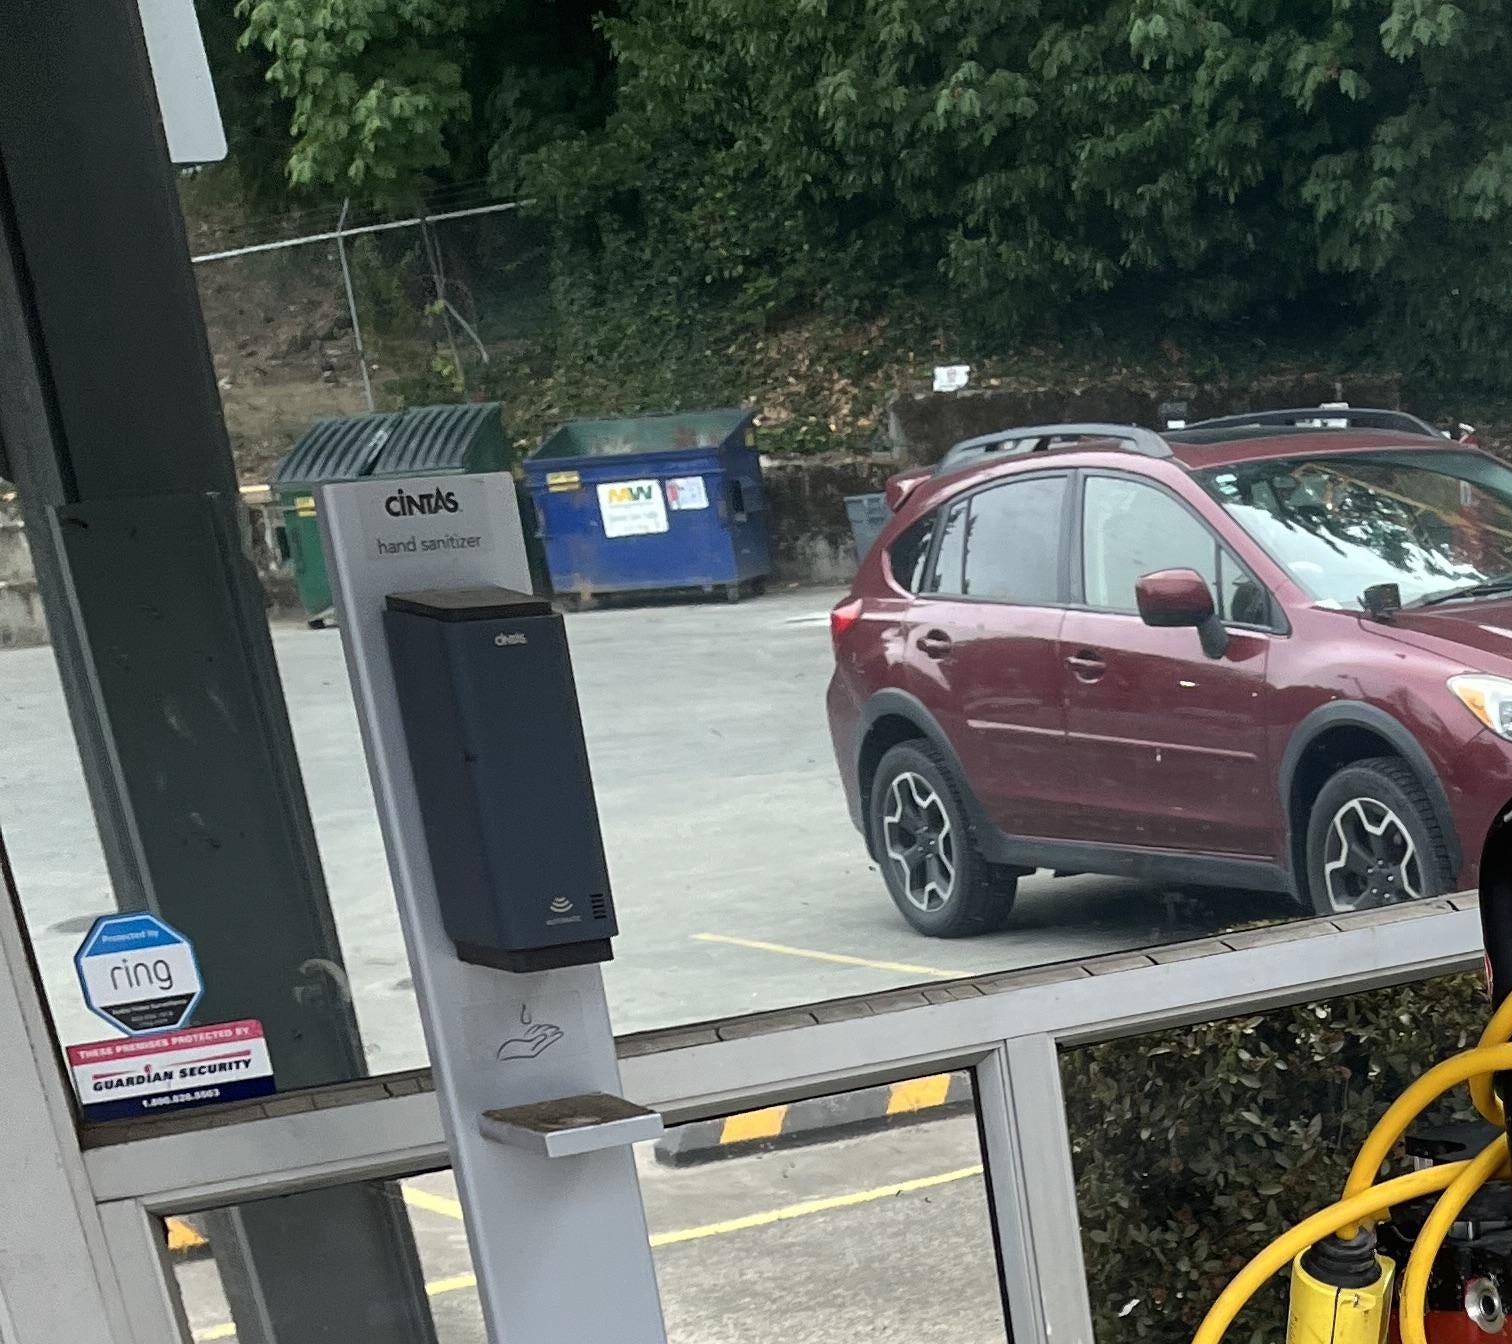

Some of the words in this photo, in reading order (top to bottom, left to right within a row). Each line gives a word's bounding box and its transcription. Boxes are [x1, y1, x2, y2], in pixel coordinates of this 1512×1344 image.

[385, 486, 459, 517] CINTAS
[376, 536, 417, 555] hand
[420, 533, 482, 552] sanitizer
[110, 958, 174, 991] ring
[79, 1047, 113, 1060] THESE
[115, 1038, 169, 1053] PREMISES
[171, 1029, 233, 1046] PROTECTED
[235, 1026, 250, 1036] BY
[93, 1069, 174, 1092] GUARDIAN
[179, 1059, 252, 1078] SECURITY
